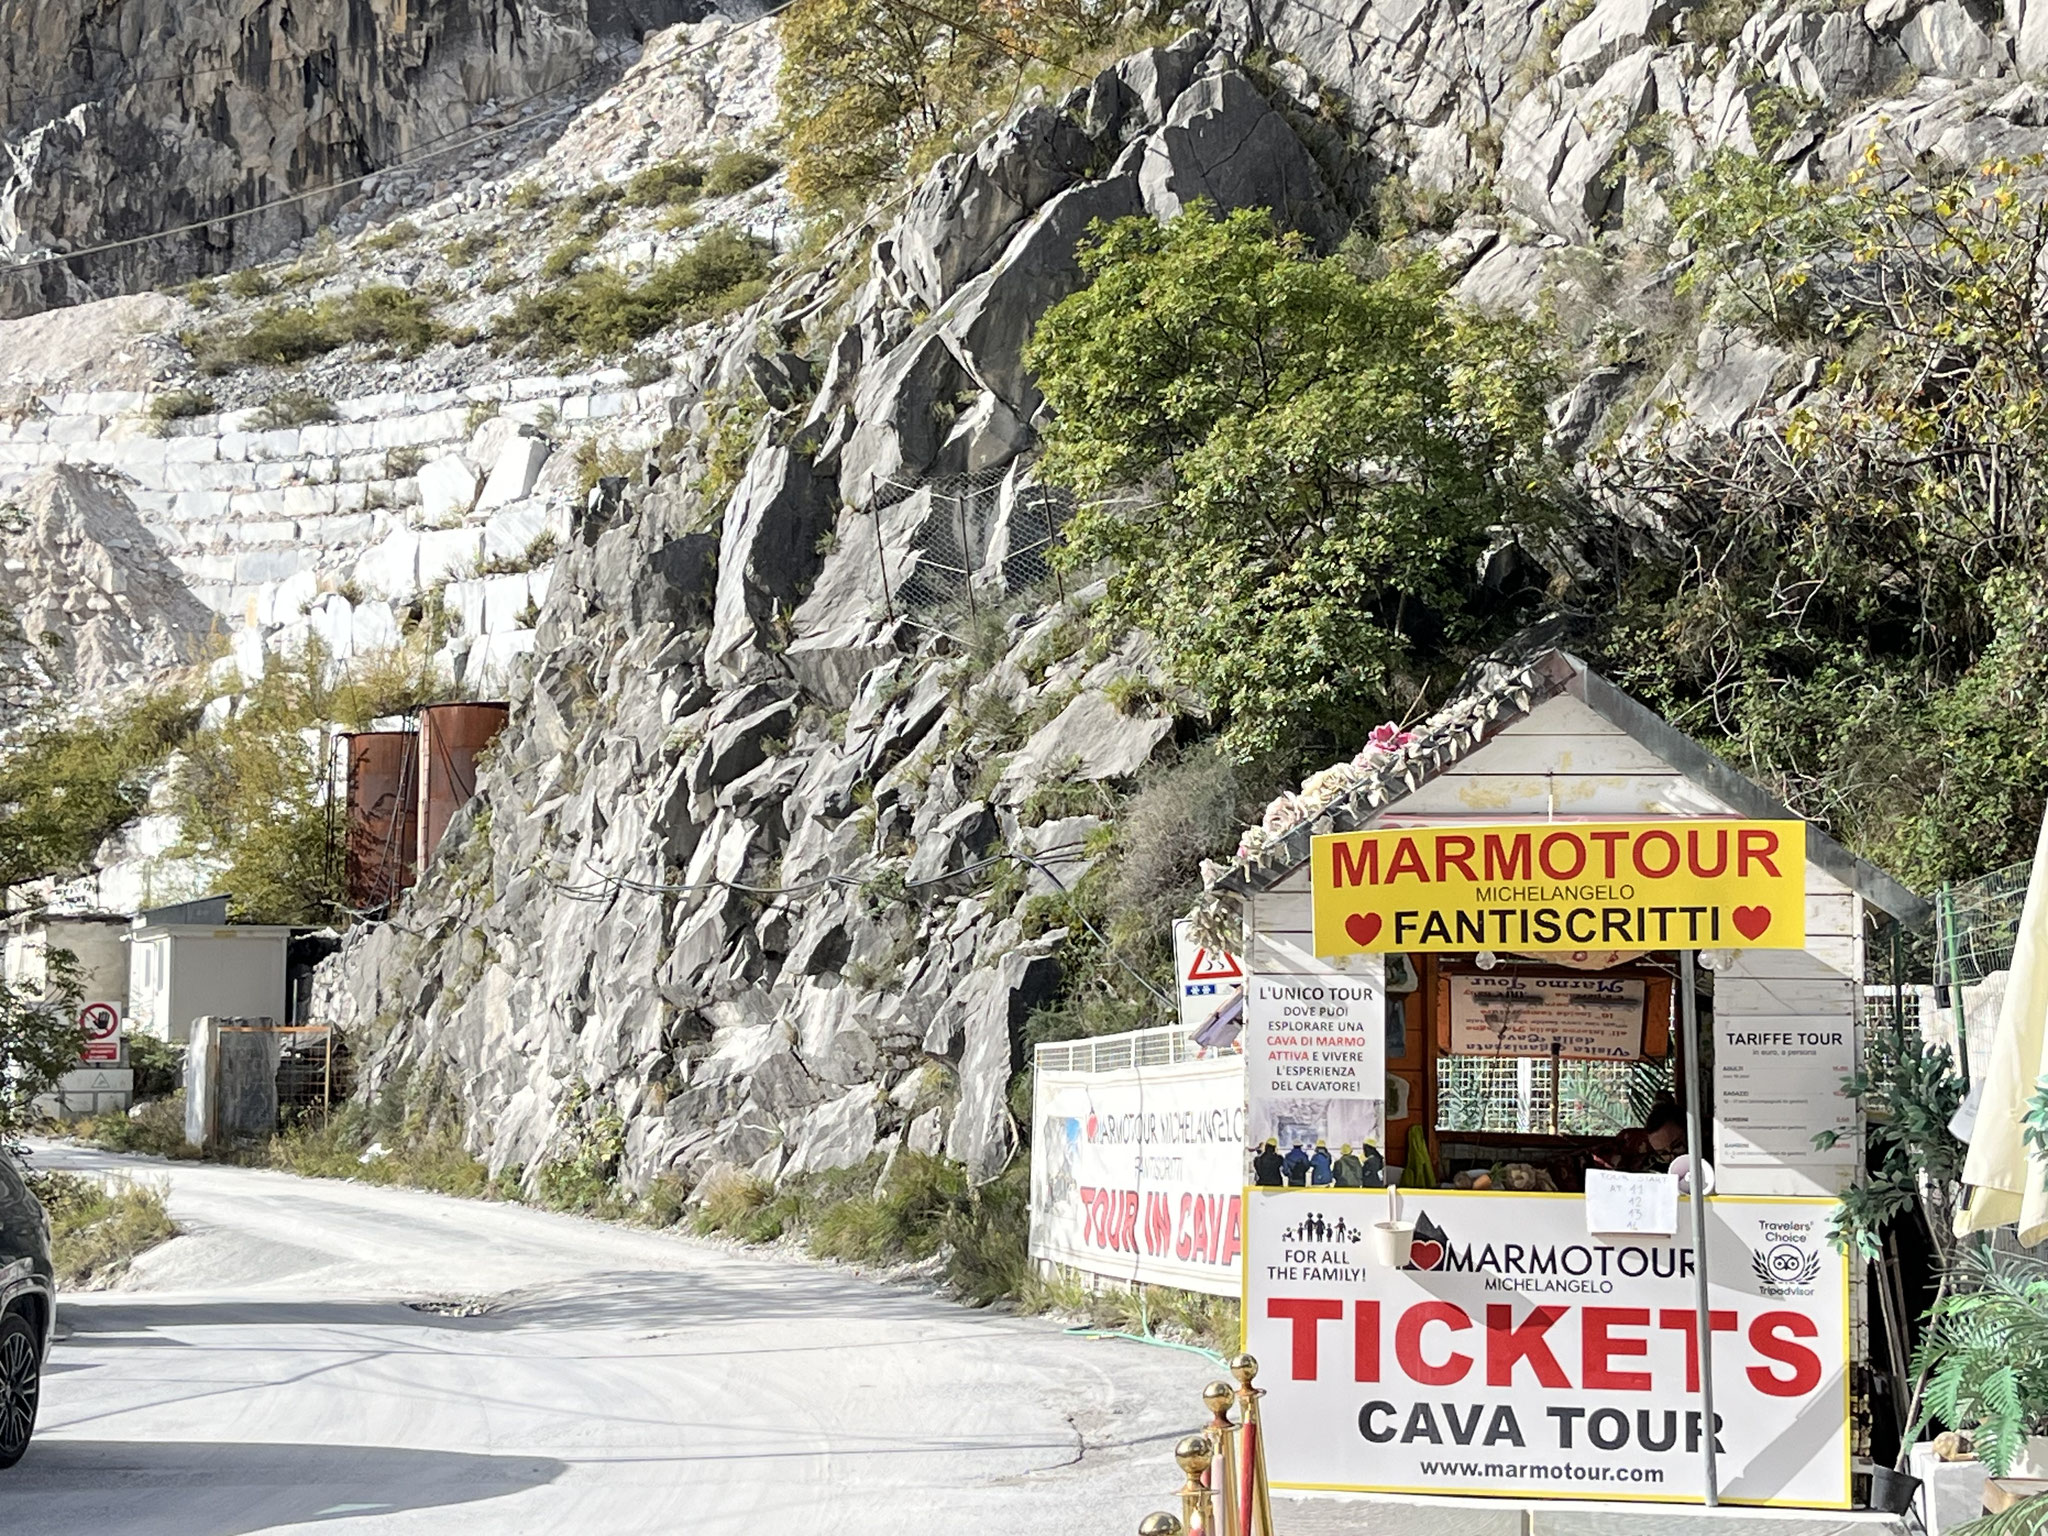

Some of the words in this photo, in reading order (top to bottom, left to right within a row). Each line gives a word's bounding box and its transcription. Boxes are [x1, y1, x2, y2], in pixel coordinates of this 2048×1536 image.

[1332, 829, 1782, 888] MARMOTOUR
[1475, 884, 1635, 902] MICHELANGELO
[1394, 905, 1720, 945] FANTISCRITTI
[1470, 977, 1526, 991] Tour
[1535, 979, 1625, 993] Marmo
[1259, 987, 1324, 1001] L'UNICO
[1328, 987, 1373, 1001] TOUR
[1284, 1006, 1316, 1017] DOVE
[1319, 1006, 1349, 1017] PUOI
[1268, 1021, 1334, 1032] ESPLORARE
[1338, 1021, 1365, 1032] UNA
[1267, 1035, 1297, 1046] CAVA
[1300, 1036, 1313, 1046] DI
[1316, 1036, 1366, 1047] MARMO
[1726, 1033, 1793, 1046] TARIFFE
[1797, 1033, 1843, 1046] TOUR
[1268, 1051, 1309, 1061] ATTIVA
[1312, 1051, 1318, 1062] E
[1322, 1051, 1364, 1062] VIVERE
[1573, 1046, 1630, 1057] Visita
[1276, 1065, 1356, 1077] L'ESPERIENZA
[1271, 1080, 1293, 1091] DEL
[1296, 1080, 1361, 1092] CAVATORE!
[1629, 1196, 1642, 1207] 12
[1080, 1186, 1140, 1255] TOUR
[1145, 1191, 1171, 1258] IN
[1176, 1191, 1242, 1266] CAVA
[1765, 1231, 1807, 1243] Choice
[1285, 1250, 1316, 1264] FOR
[1321, 1251, 1350, 1265] ALL
[1445, 1243, 1695, 1279] MARMOTOUR
[1267, 1266, 1297, 1280] THE
[1303, 1267, 1366, 1281] FAMILY!
[1485, 1278, 1614, 1294] MICHELANGELO
[1759, 1286, 1815, 1297] Tripadvisor
[1267, 1298, 1822, 1397] TICKETS
[1358, 1400, 1526, 1448] CAVA
[1546, 1406, 1727, 1454] TOUR
[1420, 1459, 1665, 1483] www.marmotour.com
